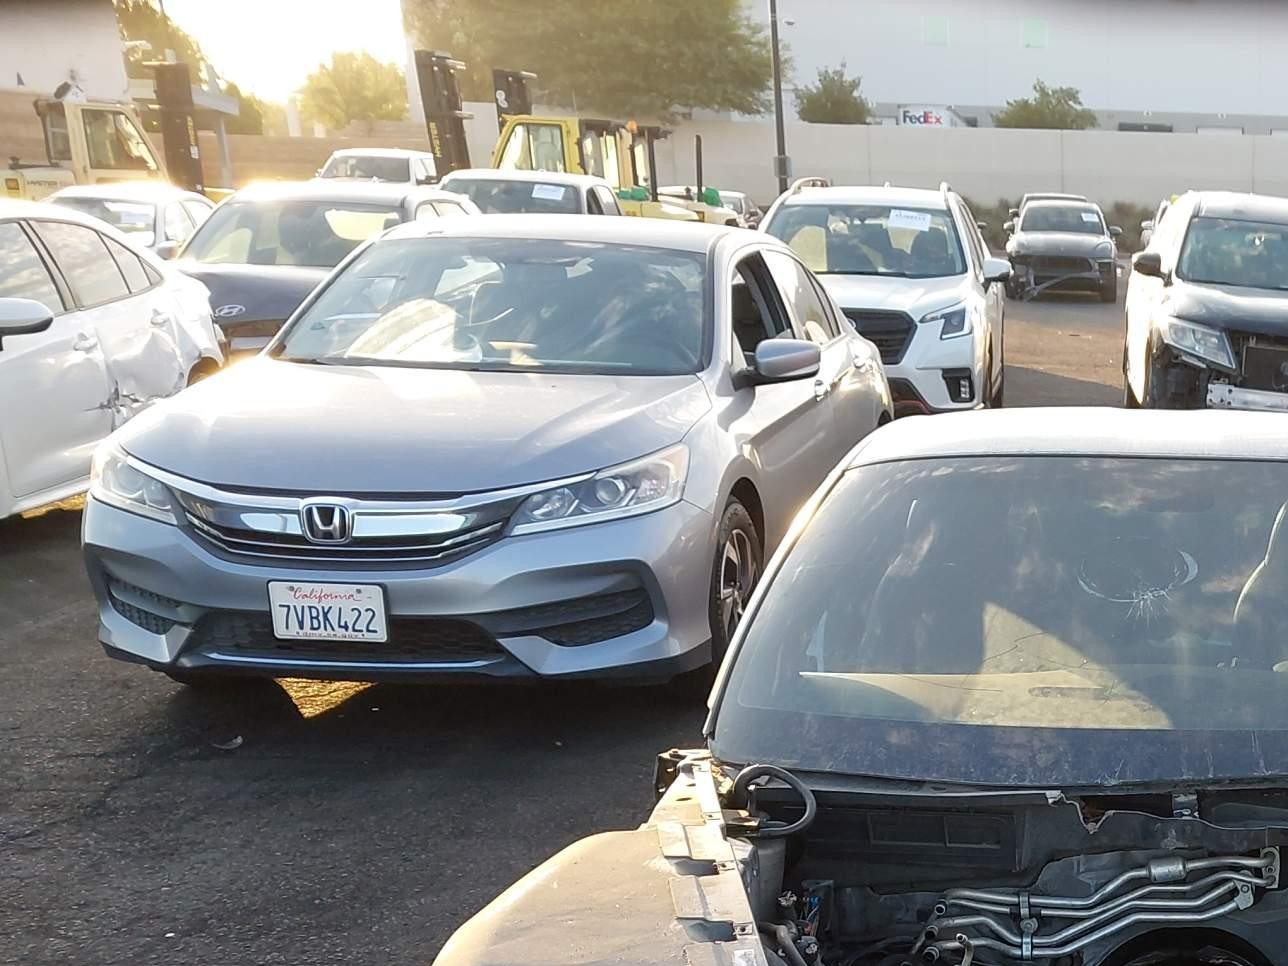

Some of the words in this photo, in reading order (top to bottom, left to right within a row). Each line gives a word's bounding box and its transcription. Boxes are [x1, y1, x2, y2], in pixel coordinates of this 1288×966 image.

[902, 110, 943, 125] FedEx
[293, 585, 362, 604] California
[278, 603, 379, 635] 7VBK422
